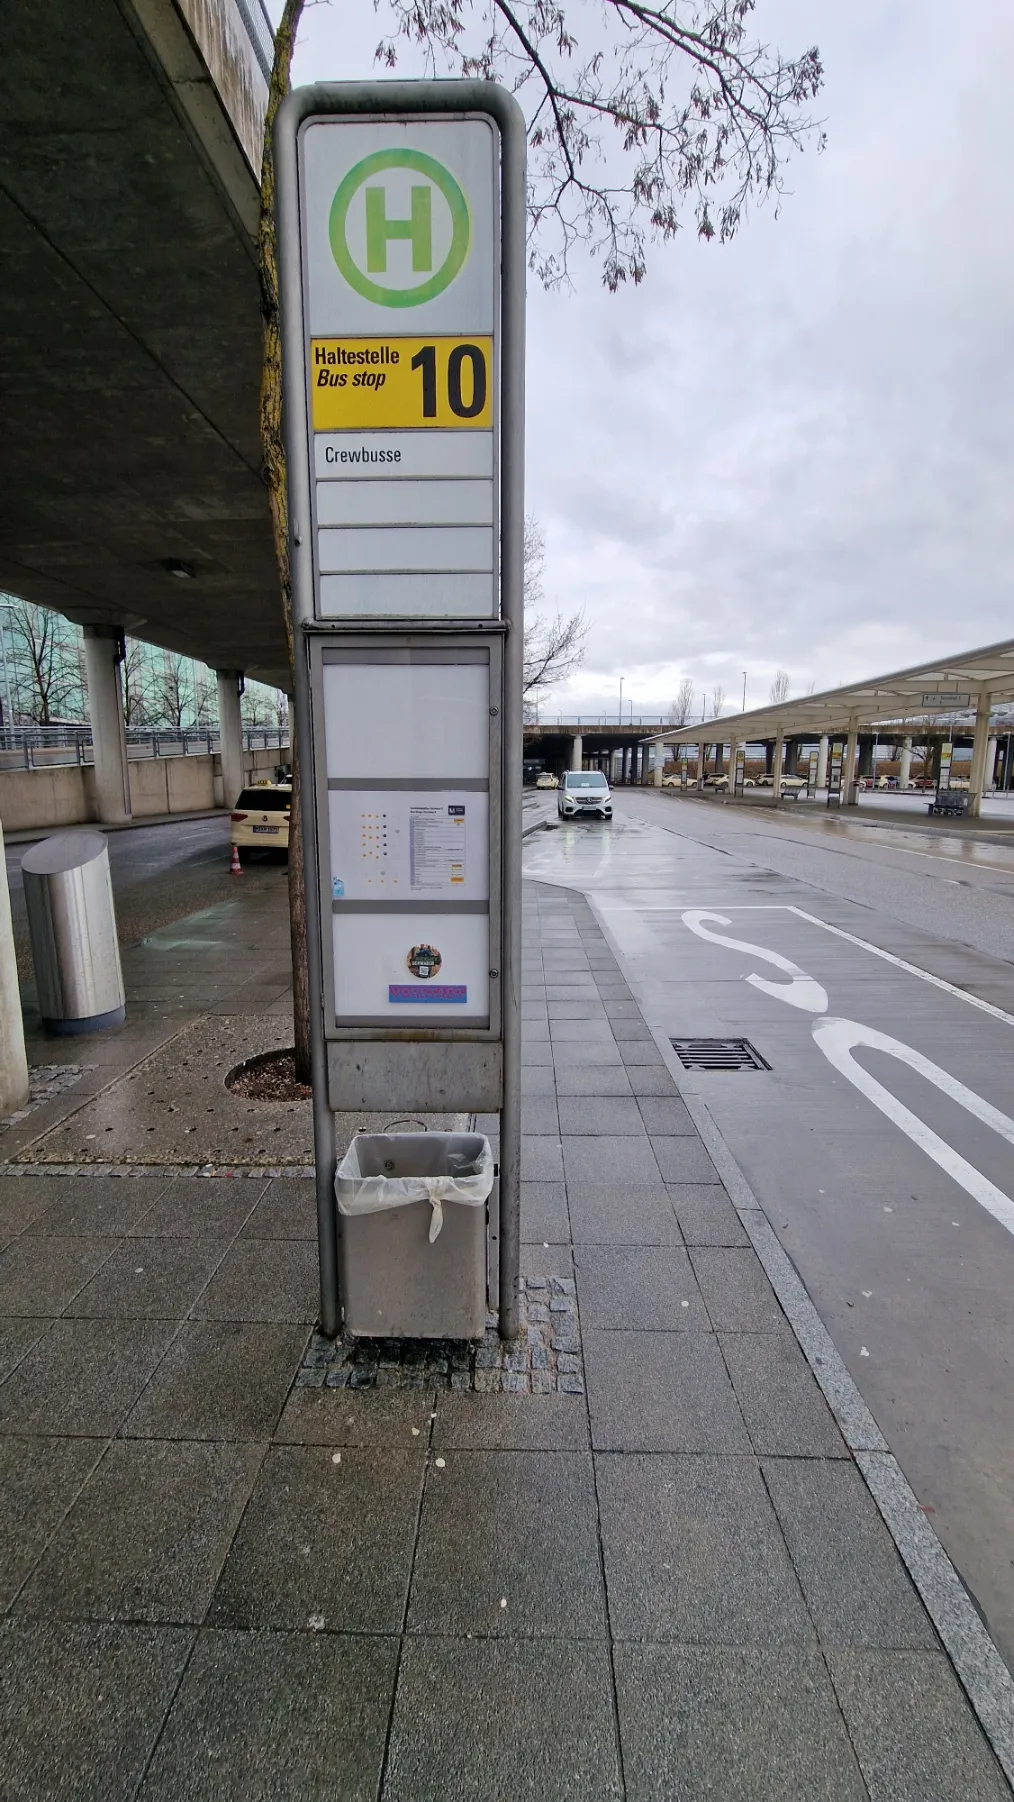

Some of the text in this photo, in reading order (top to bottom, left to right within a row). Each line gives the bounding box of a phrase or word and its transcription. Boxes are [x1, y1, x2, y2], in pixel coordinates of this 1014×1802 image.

[365, 186, 432, 273] H
[315, 346, 400, 365] Haltestelle
[317, 369, 386, 391] Bus stop
[411, 344, 487, 418] 10
[325, 446, 402, 463] Crewbusse
